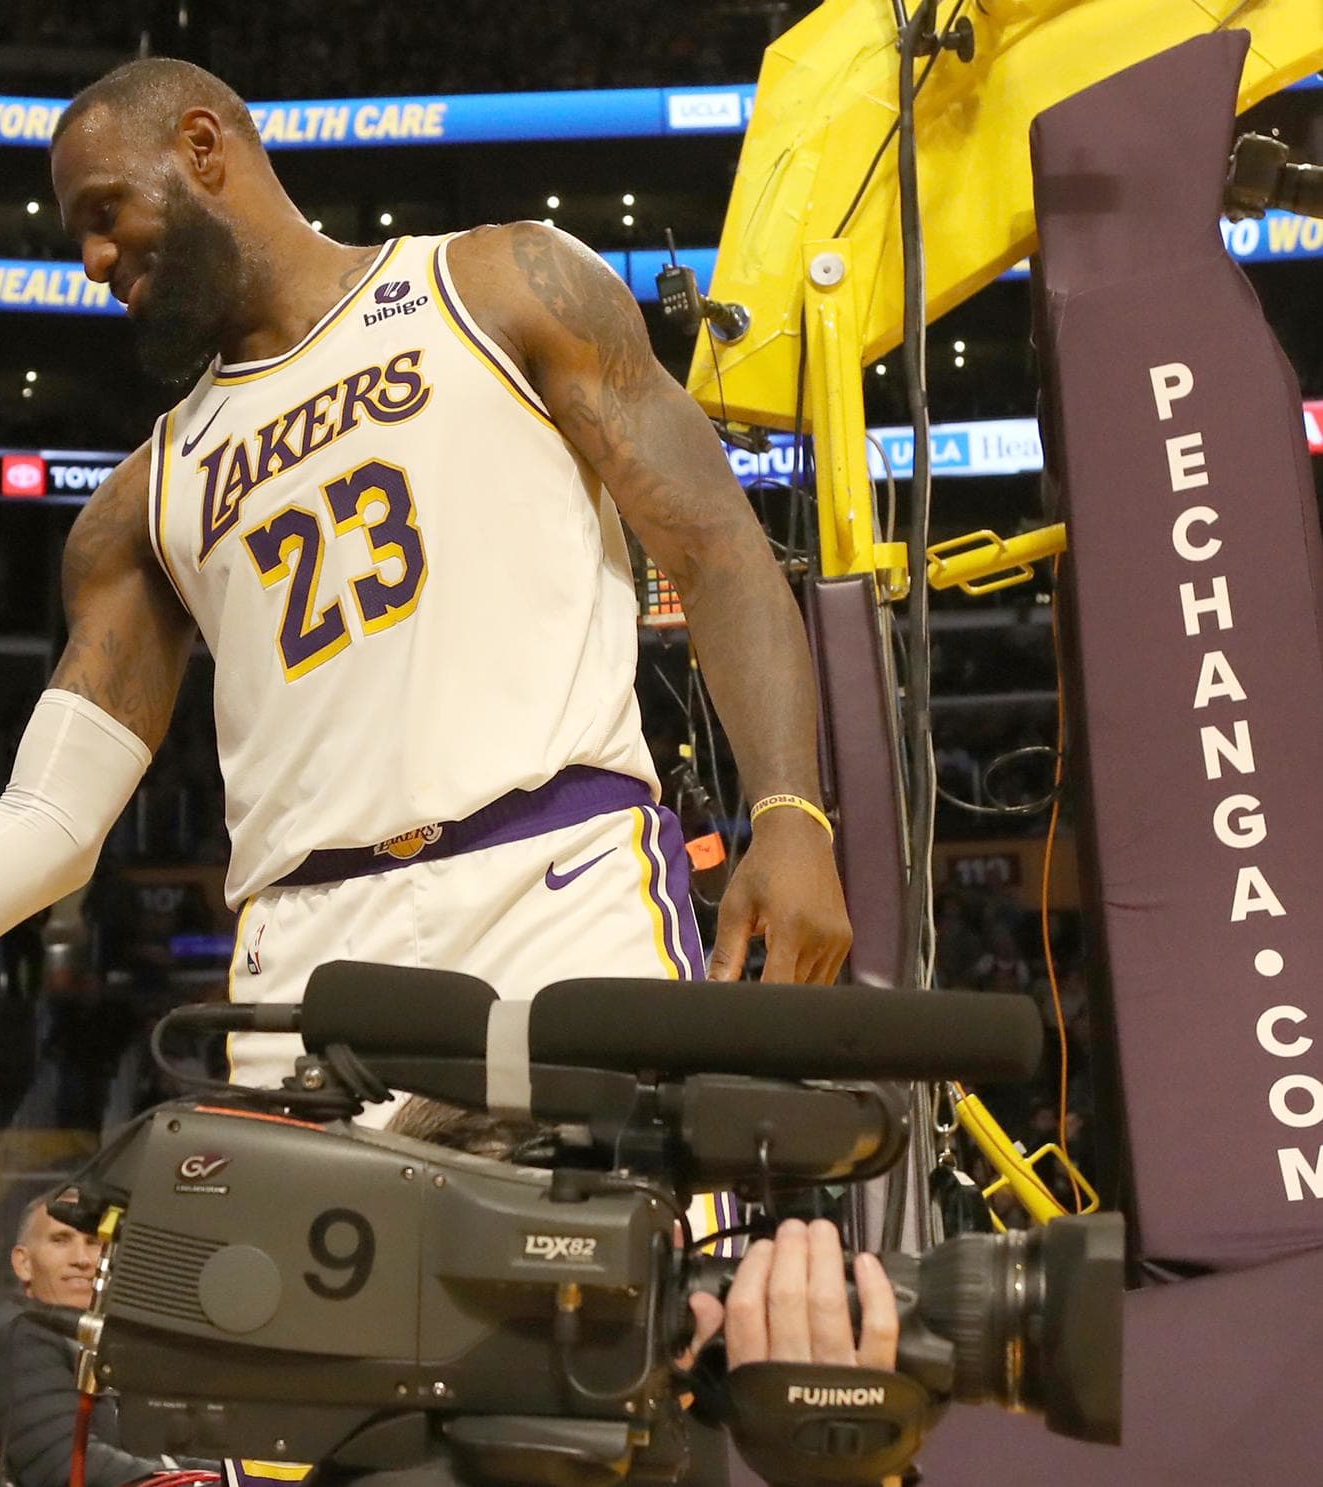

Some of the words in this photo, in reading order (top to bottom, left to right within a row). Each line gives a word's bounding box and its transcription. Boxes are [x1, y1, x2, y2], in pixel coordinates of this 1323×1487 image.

[354, 102, 448, 140] CARE
[363, 295, 428, 327] bibigo
[196, 348, 434, 572] LAKERS
[238, 456, 429, 684] 23
[303, 1206, 376, 1302] 9
[524, 1235, 598, 1260] LDX82
[787, 1385, 886, 1407] FUJINON
